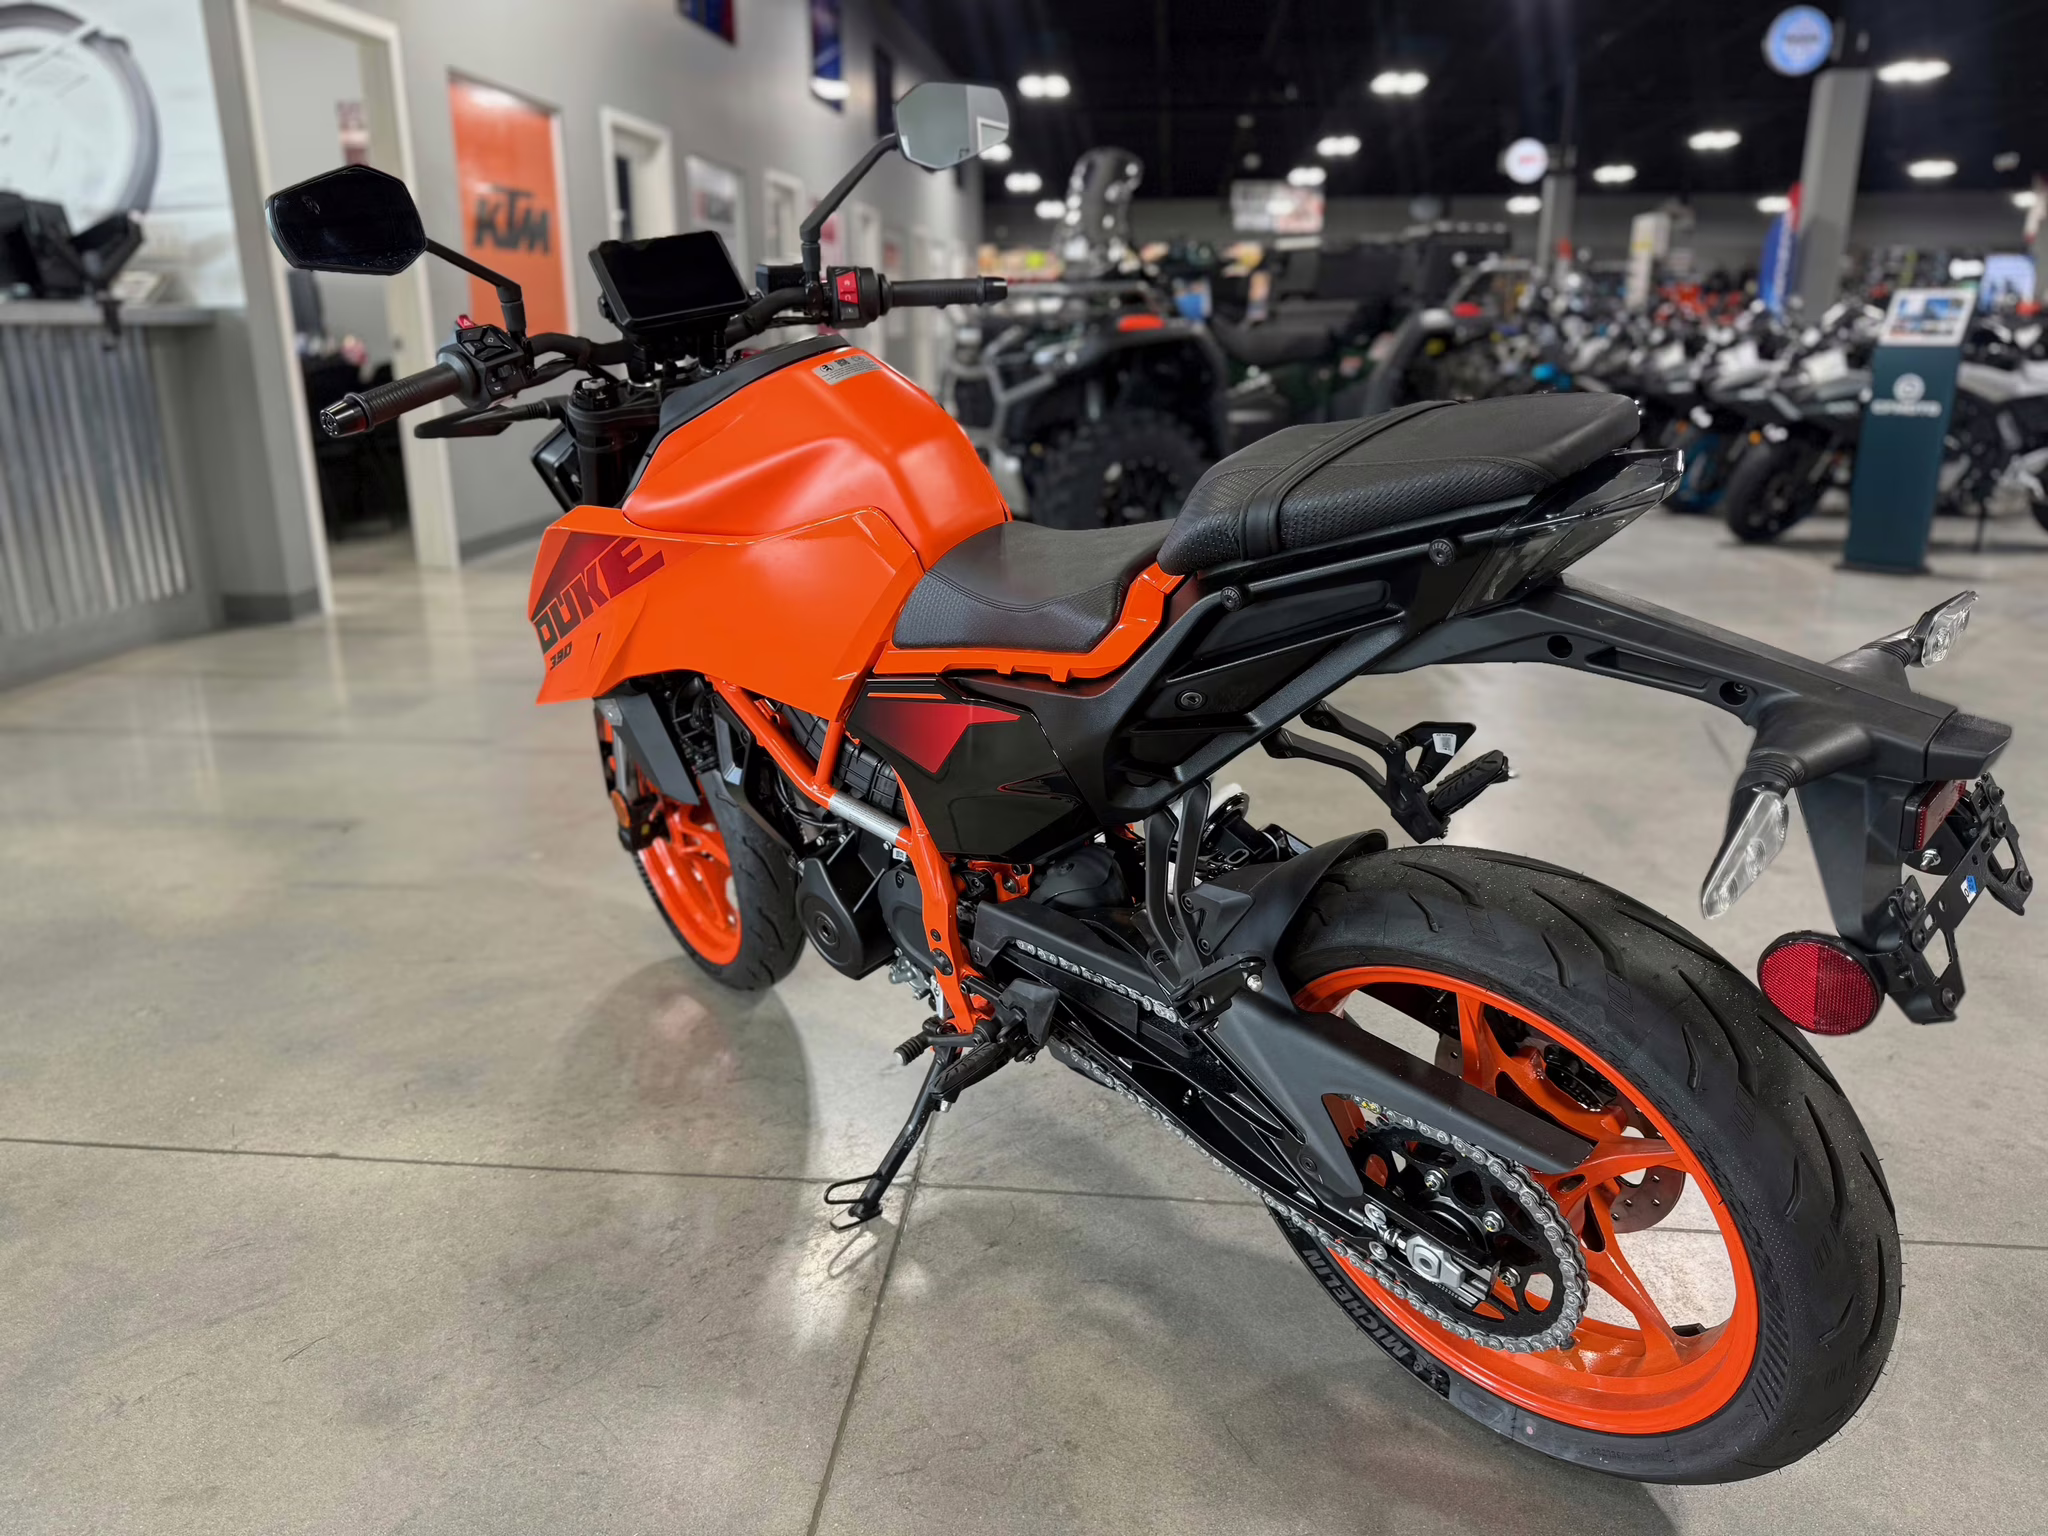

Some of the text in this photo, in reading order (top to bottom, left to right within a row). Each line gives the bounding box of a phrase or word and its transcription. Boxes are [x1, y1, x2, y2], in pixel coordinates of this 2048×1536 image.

[474, 185, 551, 257] KTM
[532, 535, 666, 655] DUKE
[549, 640, 573, 672] 390
[1302, 1250, 1411, 1359] MICHELIN
